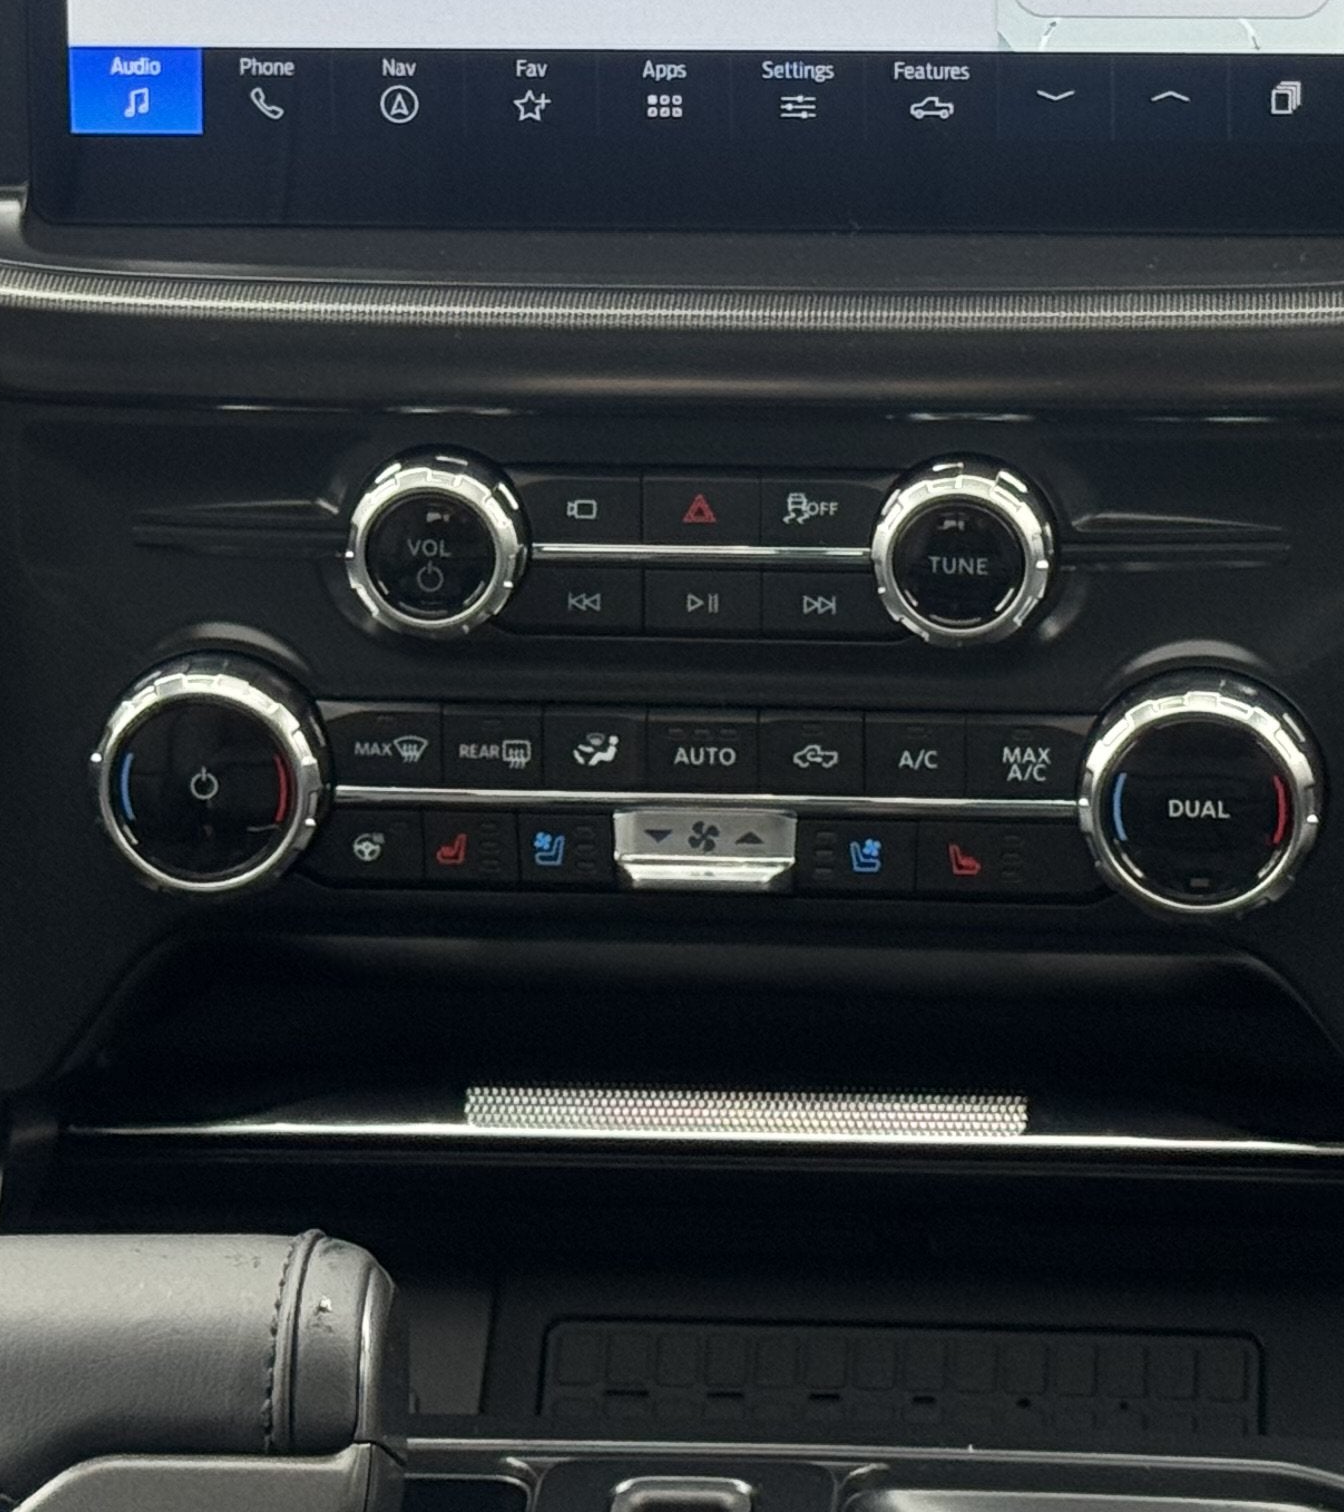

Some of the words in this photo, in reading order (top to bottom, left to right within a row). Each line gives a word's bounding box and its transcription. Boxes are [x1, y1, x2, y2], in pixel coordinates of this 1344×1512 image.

[110, 56, 161, 76] Audio
[239, 57, 295, 77] Phone
[381, 58, 416, 77] Nav
[516, 60, 548, 78] Fav
[642, 60, 687, 82] Apps
[761, 61, 835, 83] Settings
[894, 61, 970, 81] Features
[808, 502, 838, 516] OFF
[407, 539, 451, 557] VOL
[928, 556, 989, 576] TUNE
[354, 742, 393, 757] MAX
[459, 744, 500, 760] REAR
[674, 747, 736, 766] AUTO
[1003, 747, 1050, 764] MAX
[898, 749, 938, 770] A/C
[1008, 765, 1047, 782] A/C
[1168, 799, 1230, 819] DUAL
